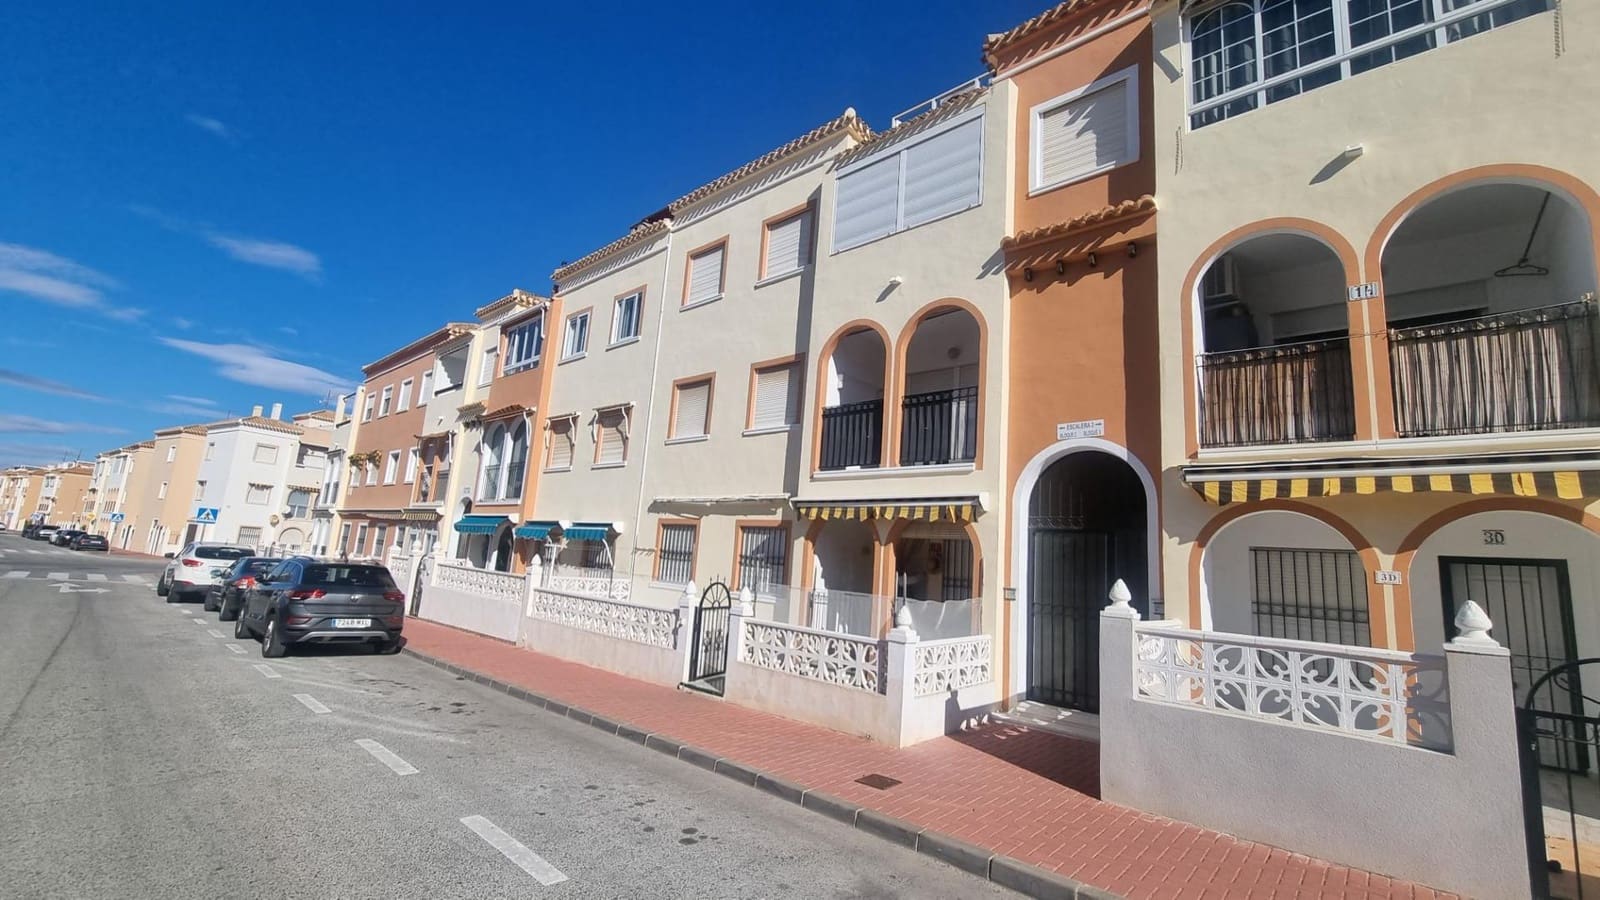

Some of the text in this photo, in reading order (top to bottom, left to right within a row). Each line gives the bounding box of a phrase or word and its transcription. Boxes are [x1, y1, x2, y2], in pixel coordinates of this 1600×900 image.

[1066, 422, 1091, 430] ESCALERA
[1483, 531, 1505, 545] 3D
[1381, 573, 1397, 582] 3D
